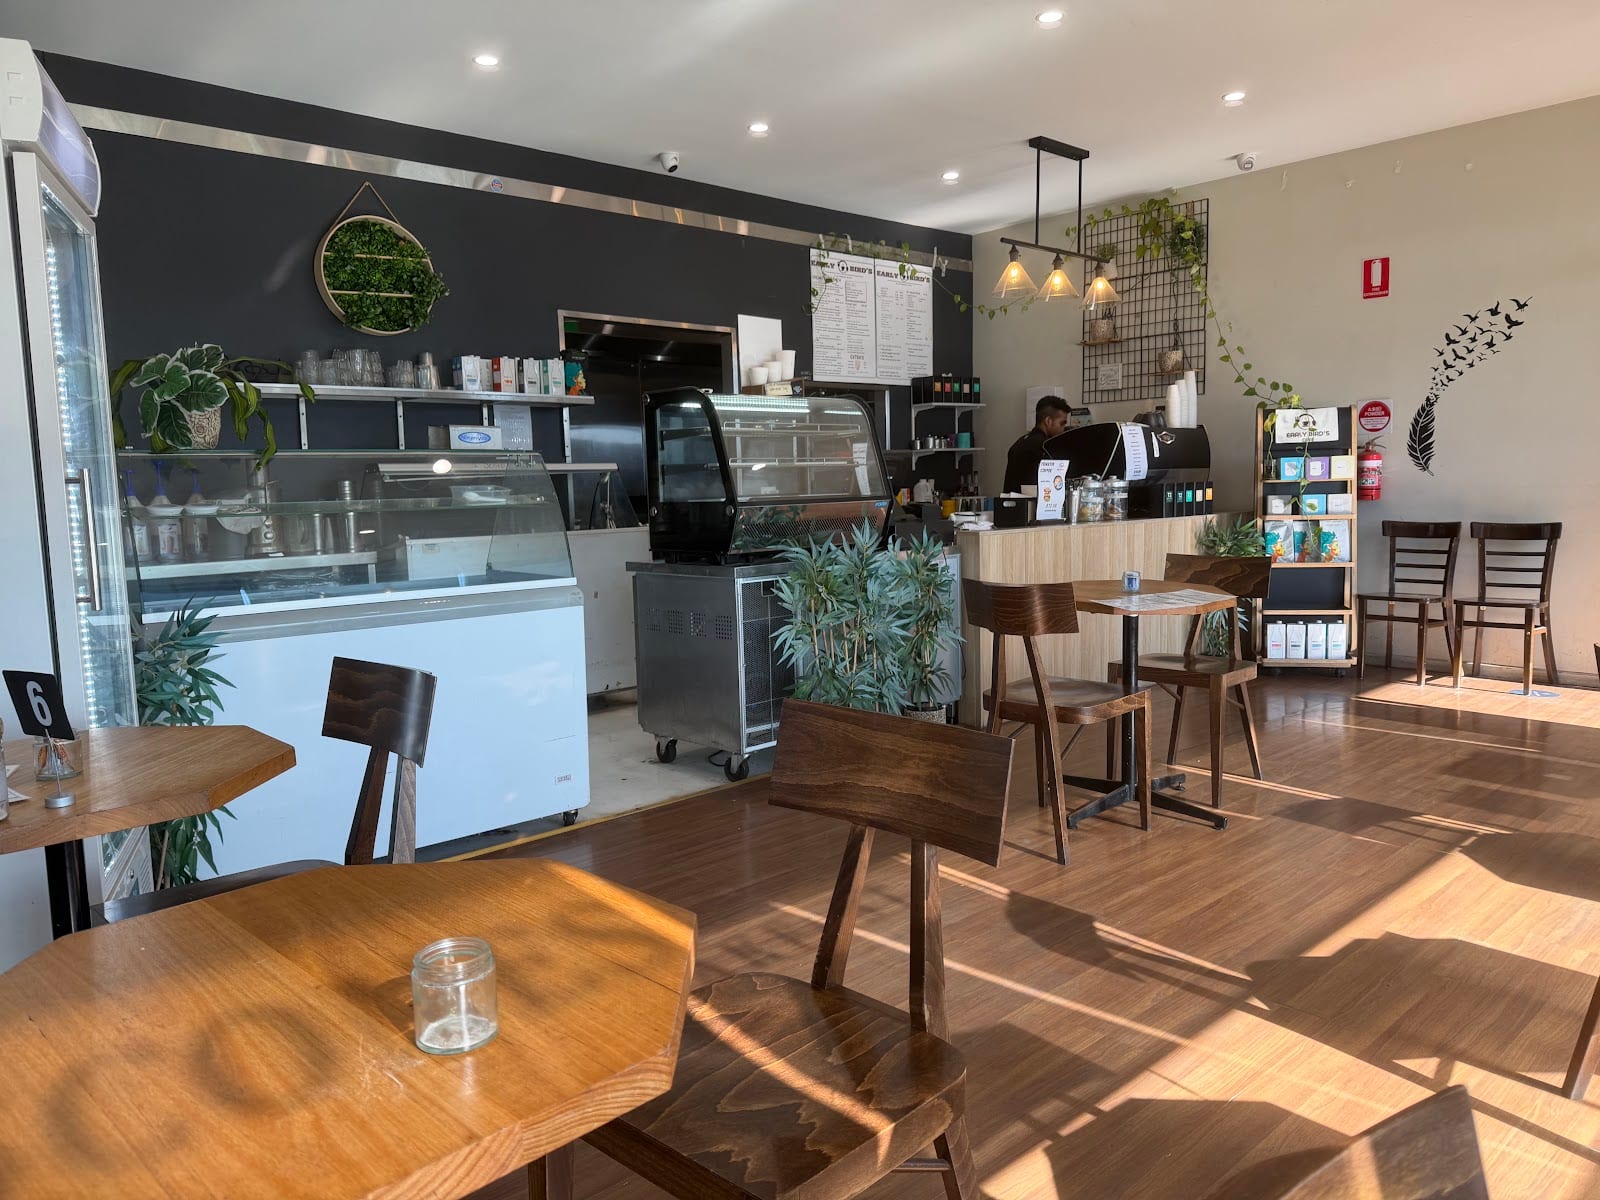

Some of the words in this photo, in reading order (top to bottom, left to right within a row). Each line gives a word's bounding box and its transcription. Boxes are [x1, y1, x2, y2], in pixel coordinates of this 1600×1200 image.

[811, 260, 835, 269] EALY
[876, 270, 899, 279] EARLY
[26, 680, 53, 727] 6
